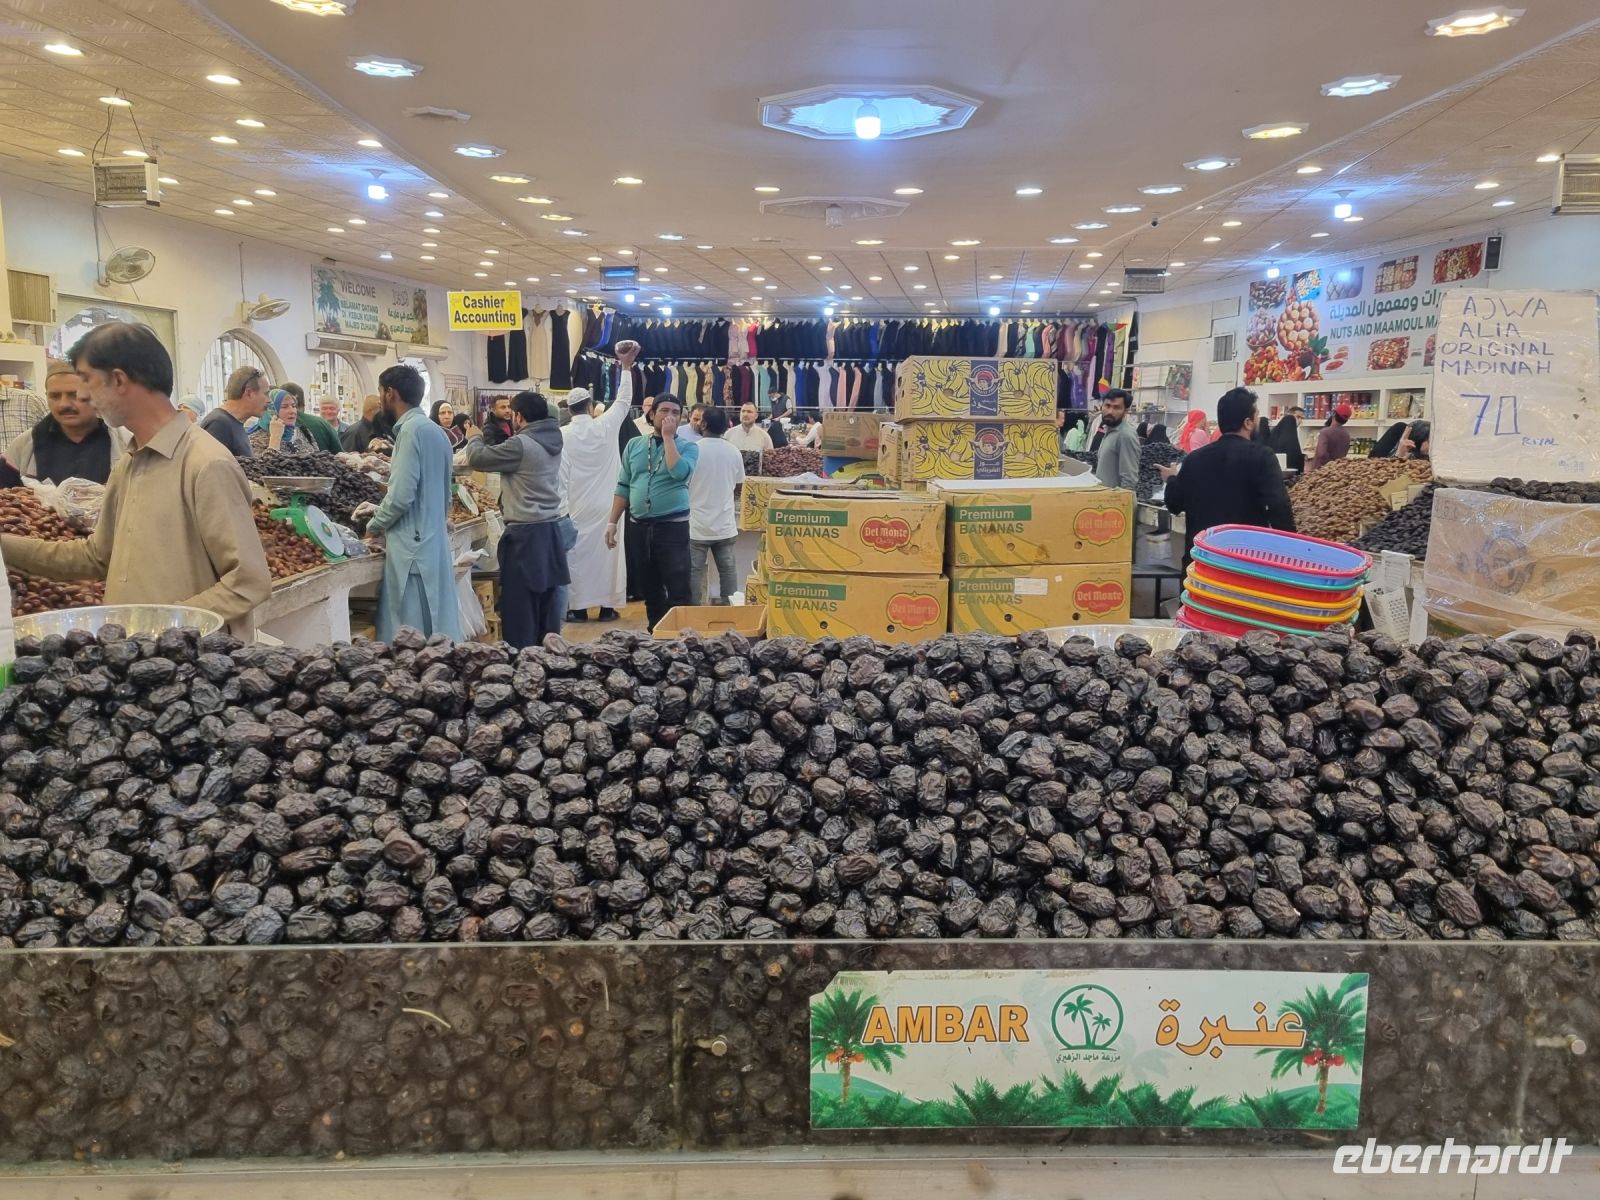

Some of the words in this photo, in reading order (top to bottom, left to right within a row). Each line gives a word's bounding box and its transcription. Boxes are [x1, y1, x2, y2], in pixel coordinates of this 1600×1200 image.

[341, 280, 376, 298] WELCOME
[463, 295, 505, 309] Cashier
[1462, 295, 1549, 320] AJWA
[454, 310, 516, 326] Accounting
[1330, 326, 1353, 339] NUTS
[1353, 323, 1372, 336] AND
[1373, 317, 1424, 335] MAAMOUL
[1441, 359, 1551, 376] MADINAH
[1460, 393, 1520, 436] 70
[775, 511, 830, 524] Premium
[959, 509, 1014, 520] Premium
[775, 526, 840, 539] BANANAS
[864, 527, 879, 537] Del
[880, 528, 908, 538] Monte
[959, 522, 1024, 535] BANANAS
[774, 584, 829, 598] Premium
[958, 580, 1013, 593] Premium
[1076, 591, 1092, 601] Del
[1092, 591, 1122, 601] Monte
[774, 599, 838, 612] BANANAS
[861, 1004, 1030, 1044] AMBAR
[1155, 998, 1306, 1059] عنبرة
[1055, 1053, 1081, 1063] الزهيري
[1083, 1053, 1099, 1062] ماجد
[1101, 1052, 1121, 1062] مزرعة
